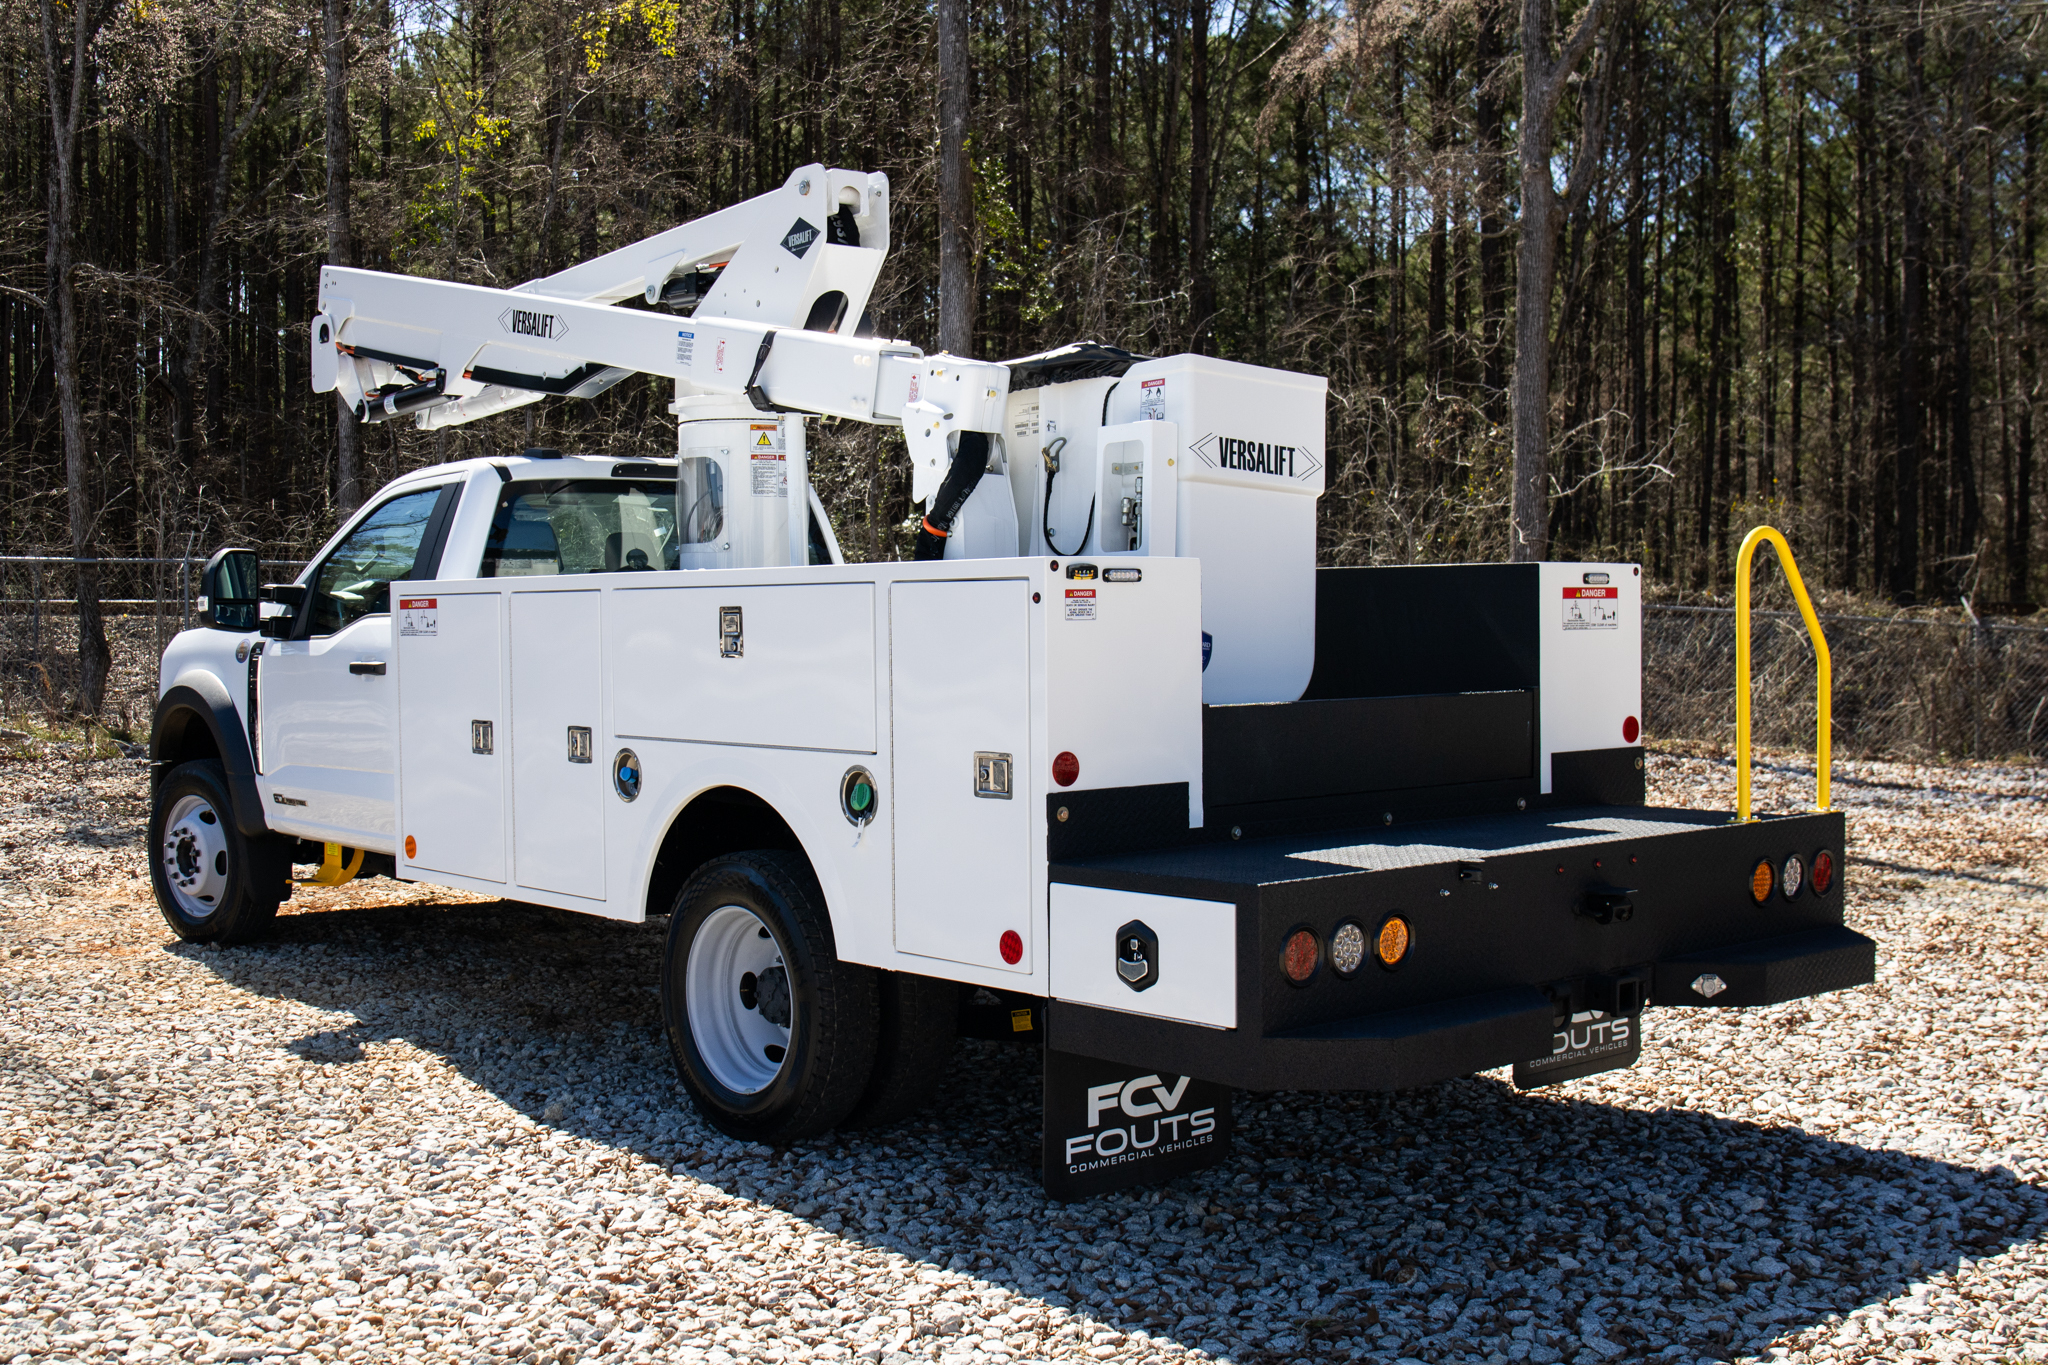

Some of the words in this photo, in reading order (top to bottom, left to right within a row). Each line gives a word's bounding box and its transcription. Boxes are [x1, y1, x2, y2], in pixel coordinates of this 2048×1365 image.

[788, 229, 812, 247] VERSALIFT
[512, 309, 555, 339] VERSALIFT
[1219, 436, 1296, 478] VERSALIFT
[412, 600, 429, 608] DANGER
[1581, 589, 1606, 597] DANGER
[1553, 1017, 1630, 1055] OUTS
[1529, 1050, 1587, 1068] COMMERCIAL
[1589, 1040, 1628, 1055] VEHICLES
[1088, 1074, 1191, 1128] FCV
[1066, 1107, 1216, 1165] FOUTS
[1069, 1149, 1155, 1174] COMMERCIAL
[1158, 1134, 1214, 1154] VEHICLES
